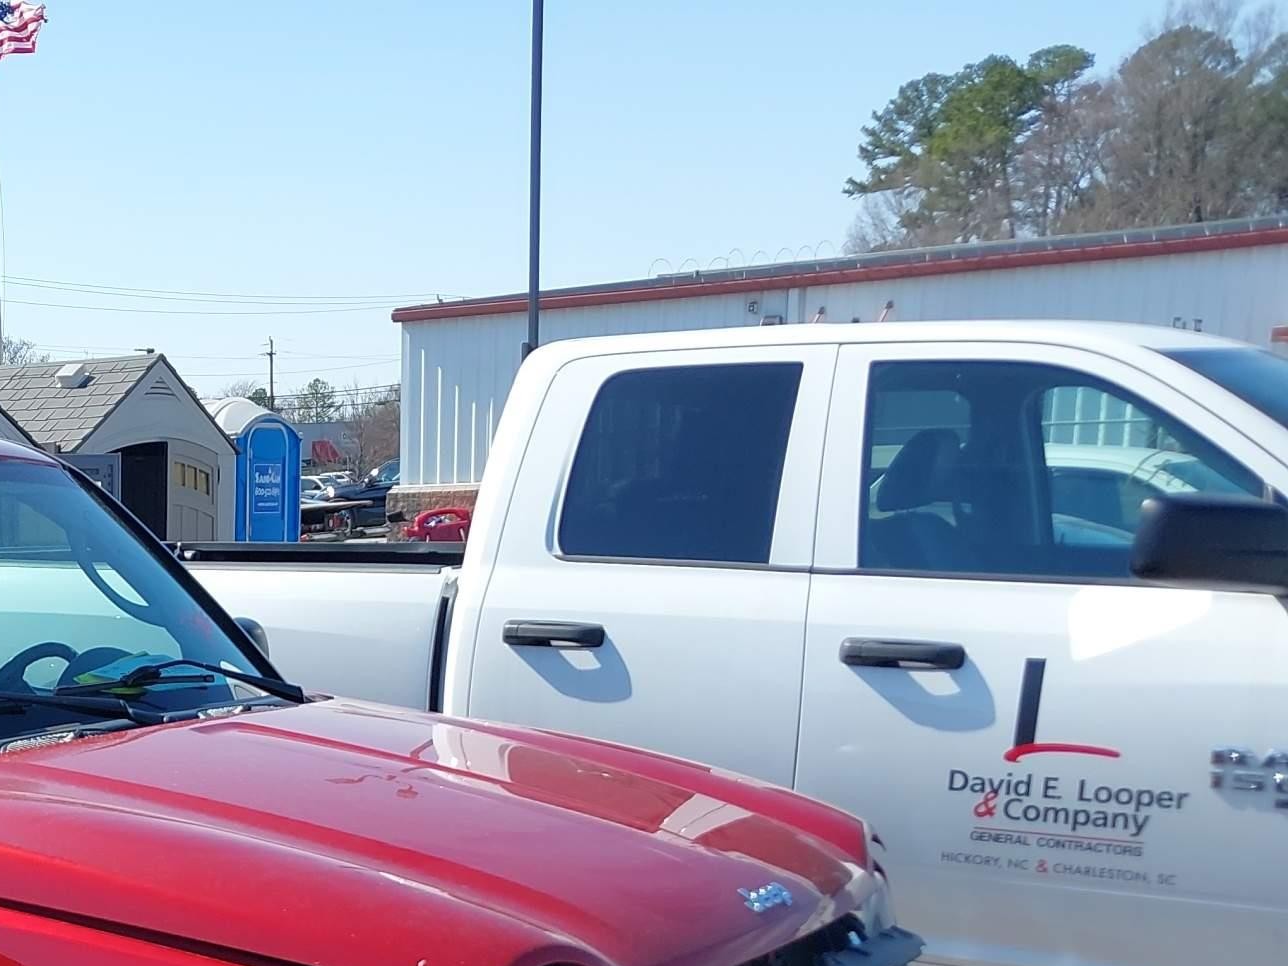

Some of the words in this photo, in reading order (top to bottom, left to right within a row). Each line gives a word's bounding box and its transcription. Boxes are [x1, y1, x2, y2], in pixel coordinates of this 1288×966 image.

[948, 769, 1033, 797] David
[1077, 779, 1191, 812] Looper
[973, 791, 996, 818] &
[1002, 797, 1150, 836] Company
[970, 830, 1031, 847] GENERAL
[1036, 837, 1144, 857] CONTRACTORS
[1007, 858, 1030, 871] NC
